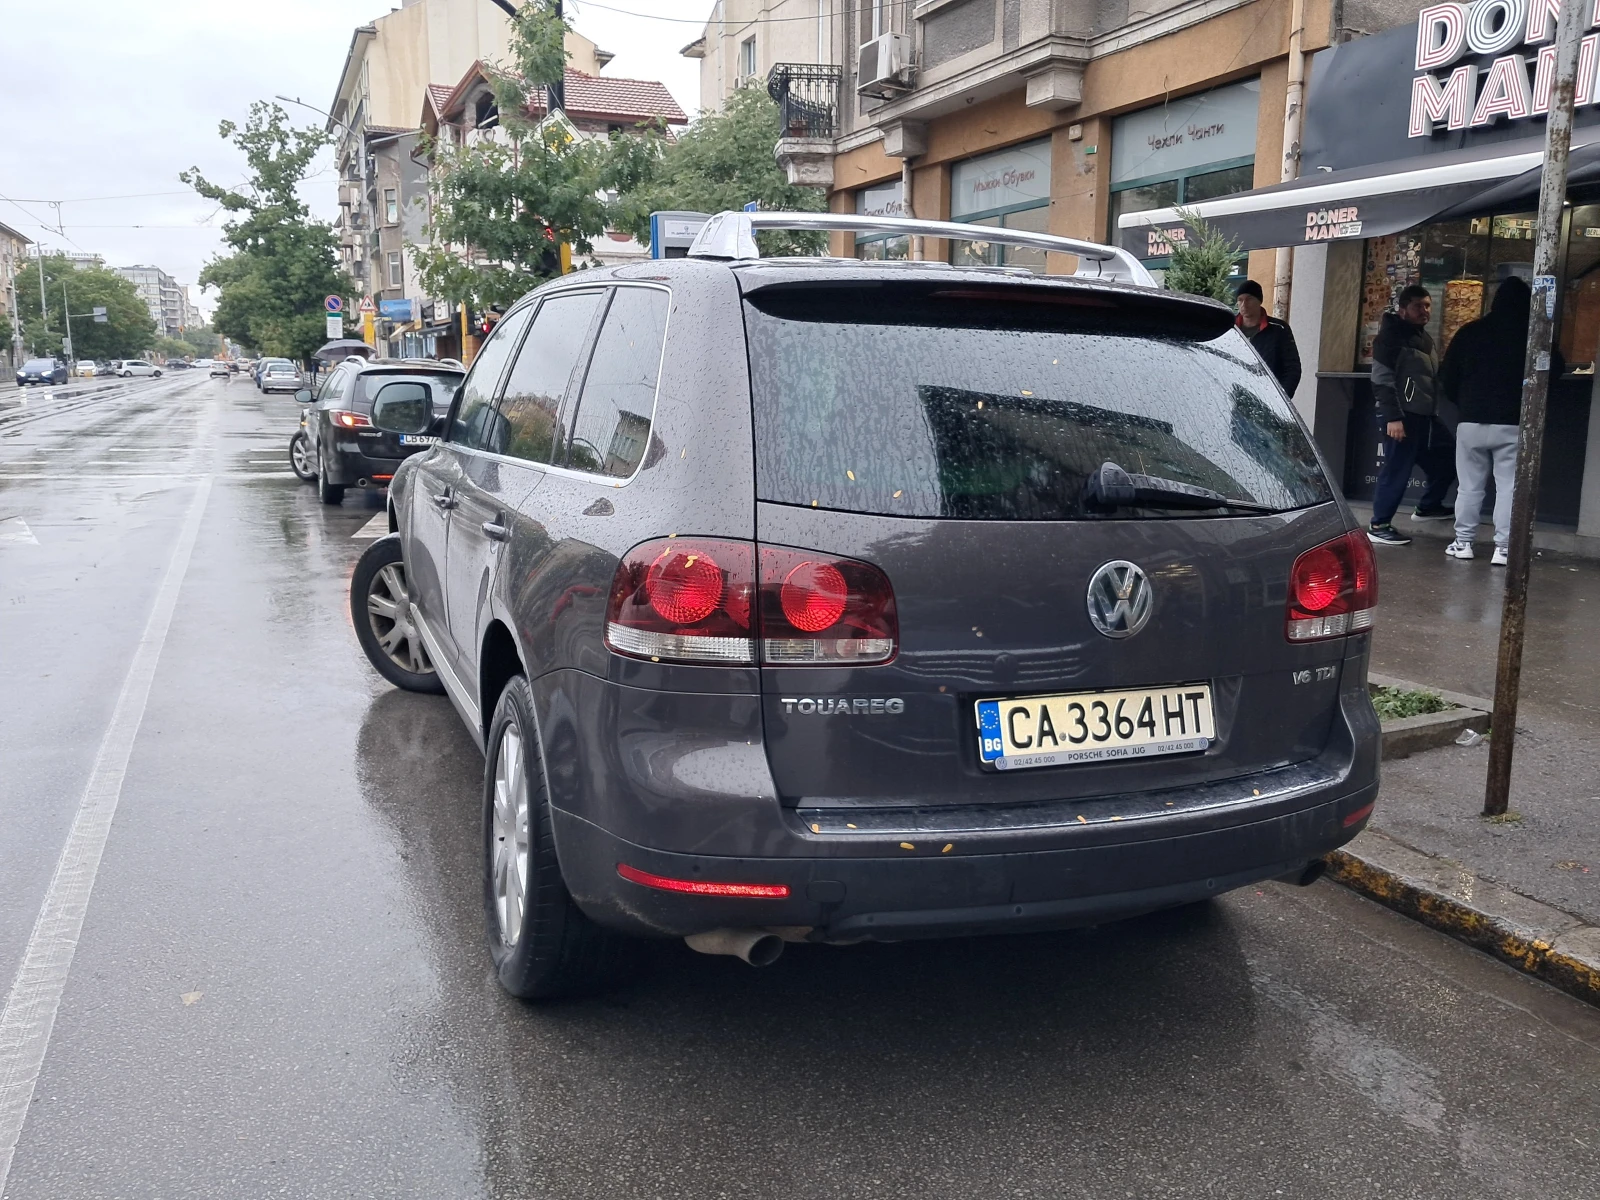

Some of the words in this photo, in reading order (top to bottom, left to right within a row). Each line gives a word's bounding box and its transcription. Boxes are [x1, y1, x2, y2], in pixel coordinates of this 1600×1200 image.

[1148, 135, 1183, 150] Чехли
[1188, 124, 1224, 141] Чанти
[1003, 169, 1035, 187] Обувки
[886, 200, 903, 216] Обув
[1306, 206, 1358, 227] DÖNER
[1305, 223, 1341, 241] MAN
[1293, 670, 1311, 685] V6
[1316, 665, 1336, 681] TDI
[781, 697, 904, 715] TOUAREG
[984, 738, 1001, 752] BG
[1044, 755, 1055, 763] 000
[1068, 751, 1103, 761] PORSCHE
[1106, 748, 1128, 758] SOFIA
[1132, 746, 1146, 755] JUG
